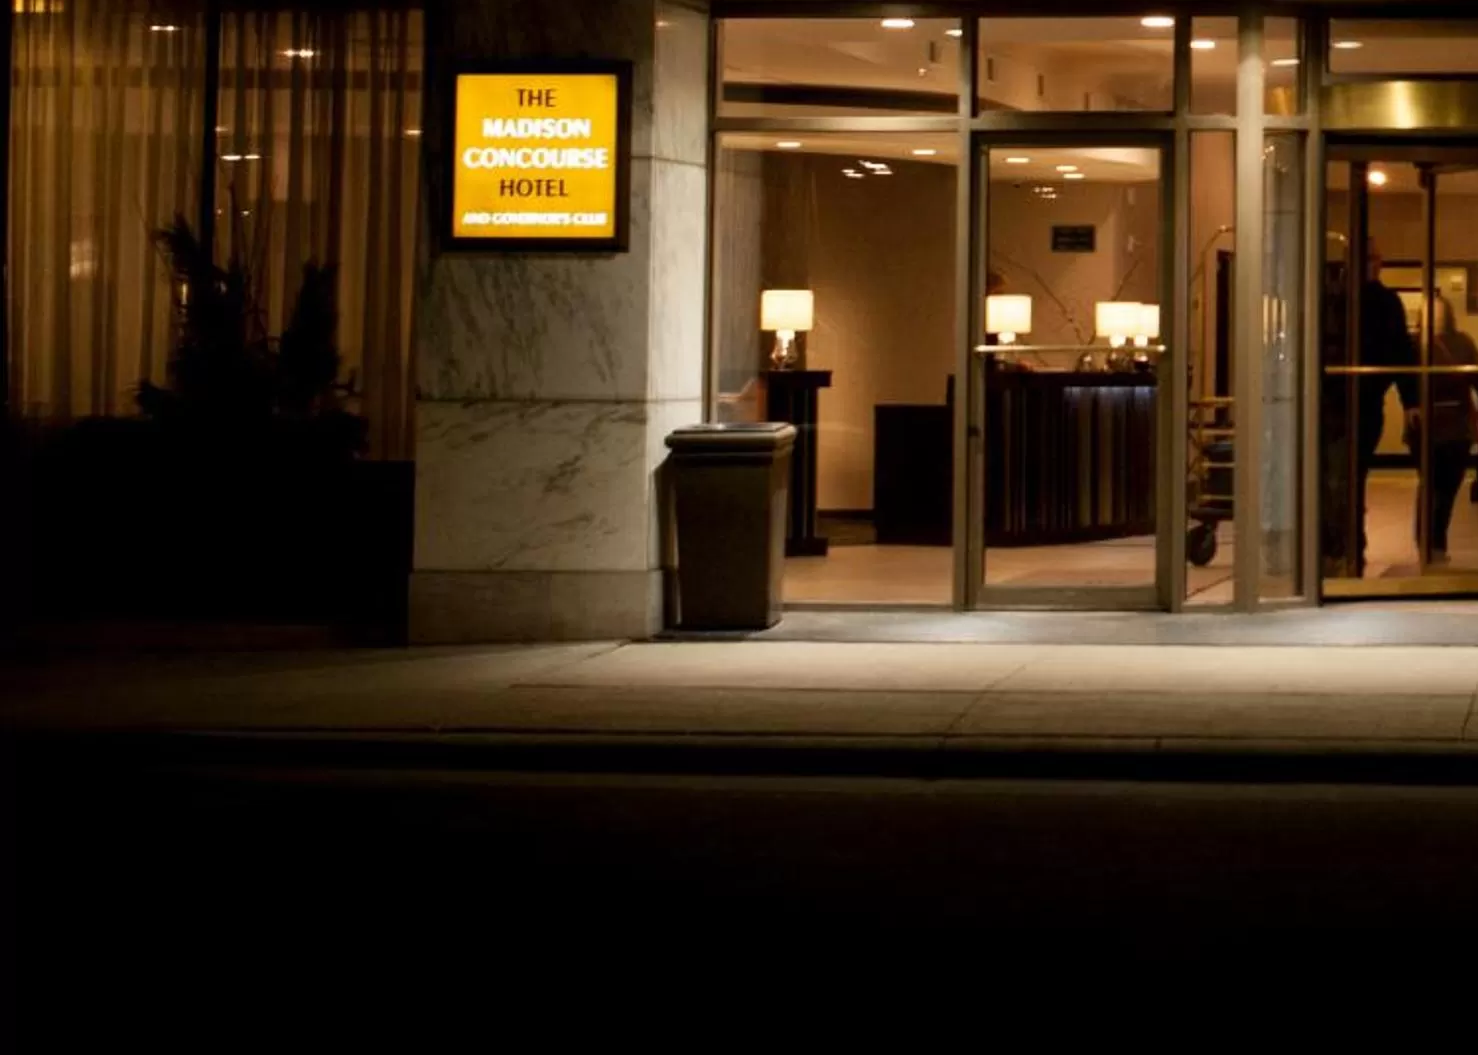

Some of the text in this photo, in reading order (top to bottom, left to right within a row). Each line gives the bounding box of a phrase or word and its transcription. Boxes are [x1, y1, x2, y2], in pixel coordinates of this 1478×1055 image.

[517, 89, 557, 107] THE
[483, 118, 592, 138] MADISON
[463, 147, 608, 168] CONCOURSE
[500, 178, 568, 197] HOTEL
